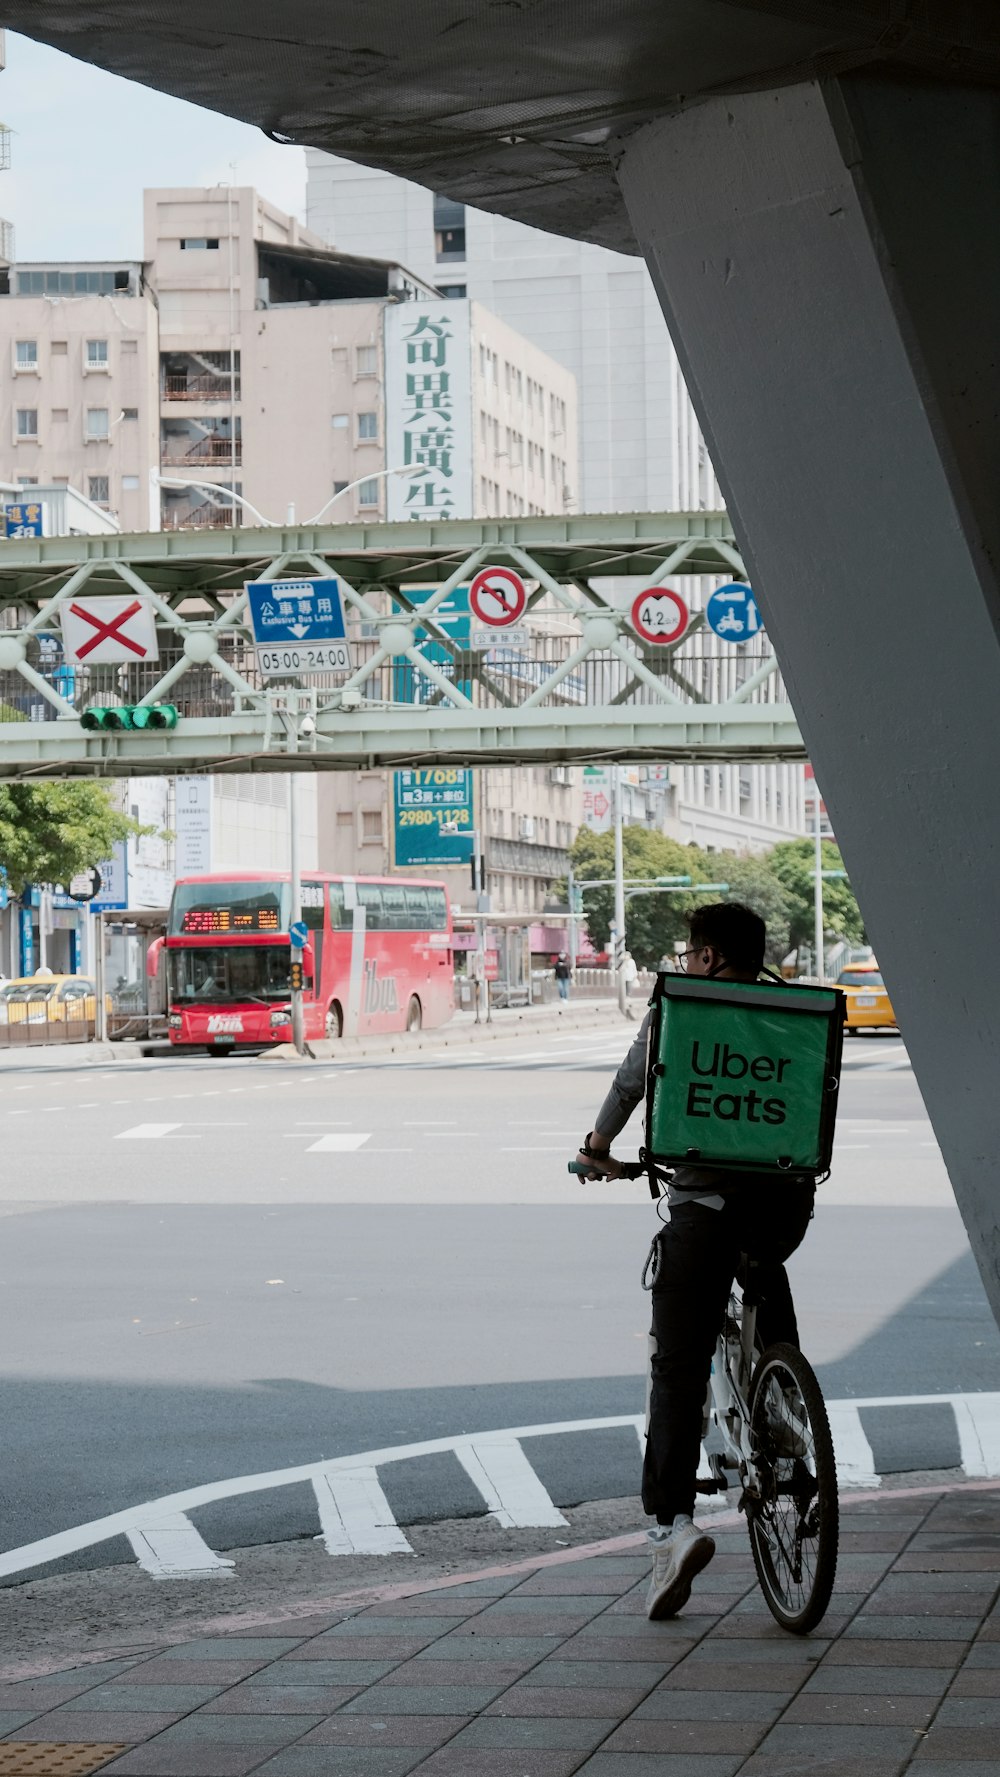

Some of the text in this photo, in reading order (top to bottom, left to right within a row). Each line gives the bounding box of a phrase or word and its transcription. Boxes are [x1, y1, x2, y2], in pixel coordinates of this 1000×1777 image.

[260, 598, 332, 616] 公車專用
[261, 613, 334, 625] Exclusive Bus Lane
[478, 633, 521, 644] 公車除外
[398, 808, 469, 826] 2980-1128
[691, 1040, 792, 1083] Uber
[686, 1082, 786, 1125] Eats
